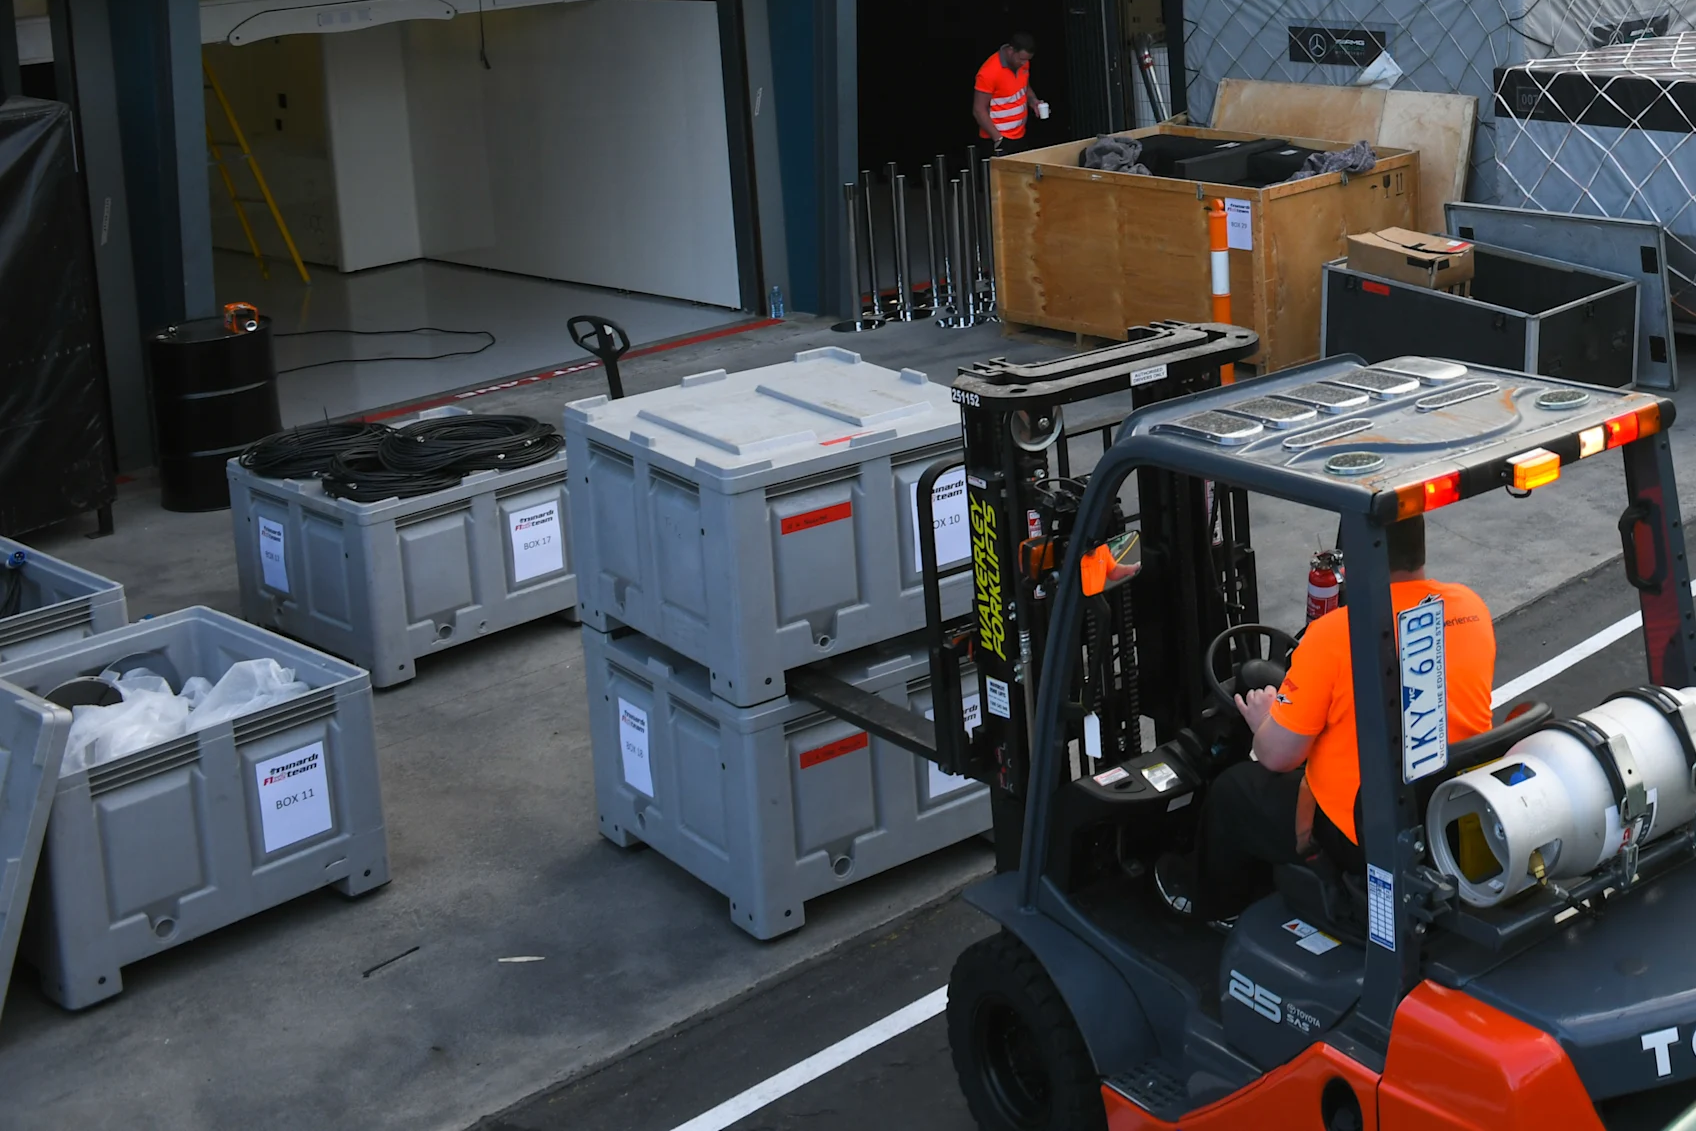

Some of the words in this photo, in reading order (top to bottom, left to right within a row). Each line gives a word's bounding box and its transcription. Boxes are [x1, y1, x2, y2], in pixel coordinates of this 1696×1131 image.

[951, 388, 980, 407] 251152
[936, 489, 963, 501] team
[531, 516, 553, 527] team
[932, 517, 946, 530] OX
[949, 514, 960, 525] 10
[523, 539, 540, 550] BOX
[542, 535, 551, 545] 17
[969, 492, 994, 652] WAVERLEY
[982, 499, 1007, 662] FORKLIFTS
[1407, 611, 1435, 675] 6UB
[1411, 707, 1439, 769] 1KY
[1438, 717, 1446, 760] VICTORIA
[287, 763, 317, 777] team
[276, 793, 299, 810] BOX
[302, 788, 315, 801] 11
[1229, 970, 1282, 1024] 25
[1286, 1014, 1310, 1032] SAS
[1296, 1009, 1321, 1029] TOYOTA
